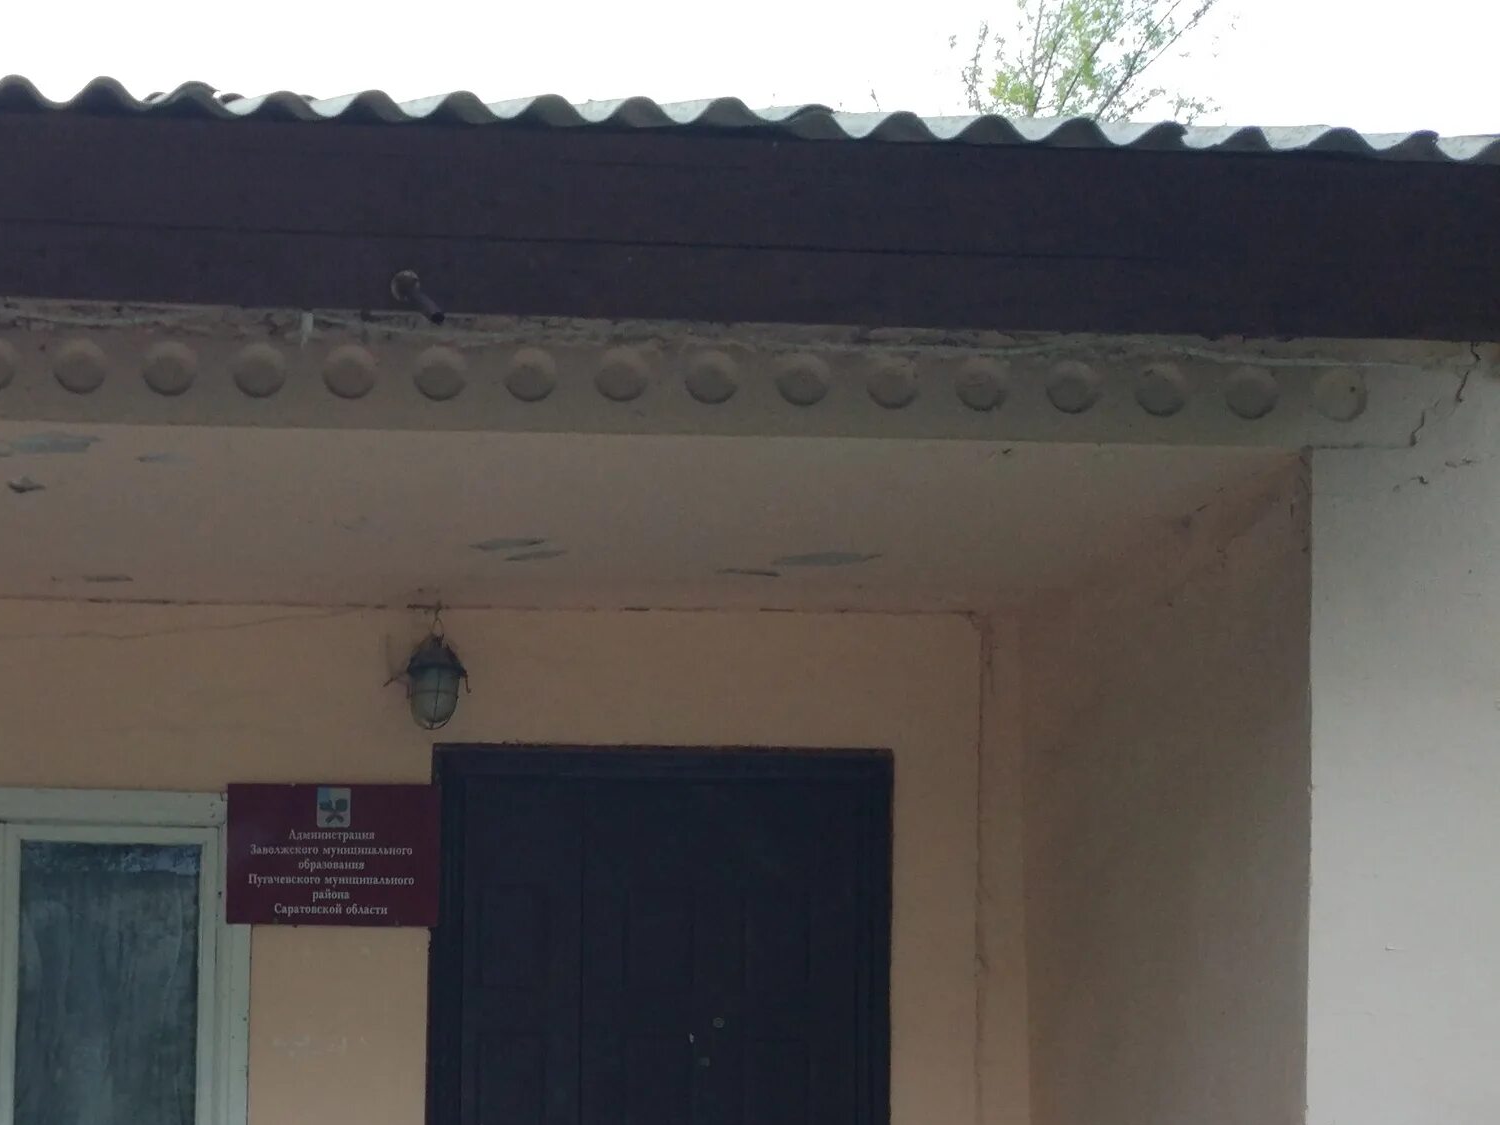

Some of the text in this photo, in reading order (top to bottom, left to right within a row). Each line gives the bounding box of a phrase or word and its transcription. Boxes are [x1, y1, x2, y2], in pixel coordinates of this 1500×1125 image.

[288, 829, 375, 843] Администрация
[250, 844, 413, 858] Заволжского муниципального
[298, 859, 365, 872] образования
[248, 874, 415, 889] Пугачевского муниципального
[312, 889, 350, 902] района
[274, 903, 388, 916] Саратовской области
